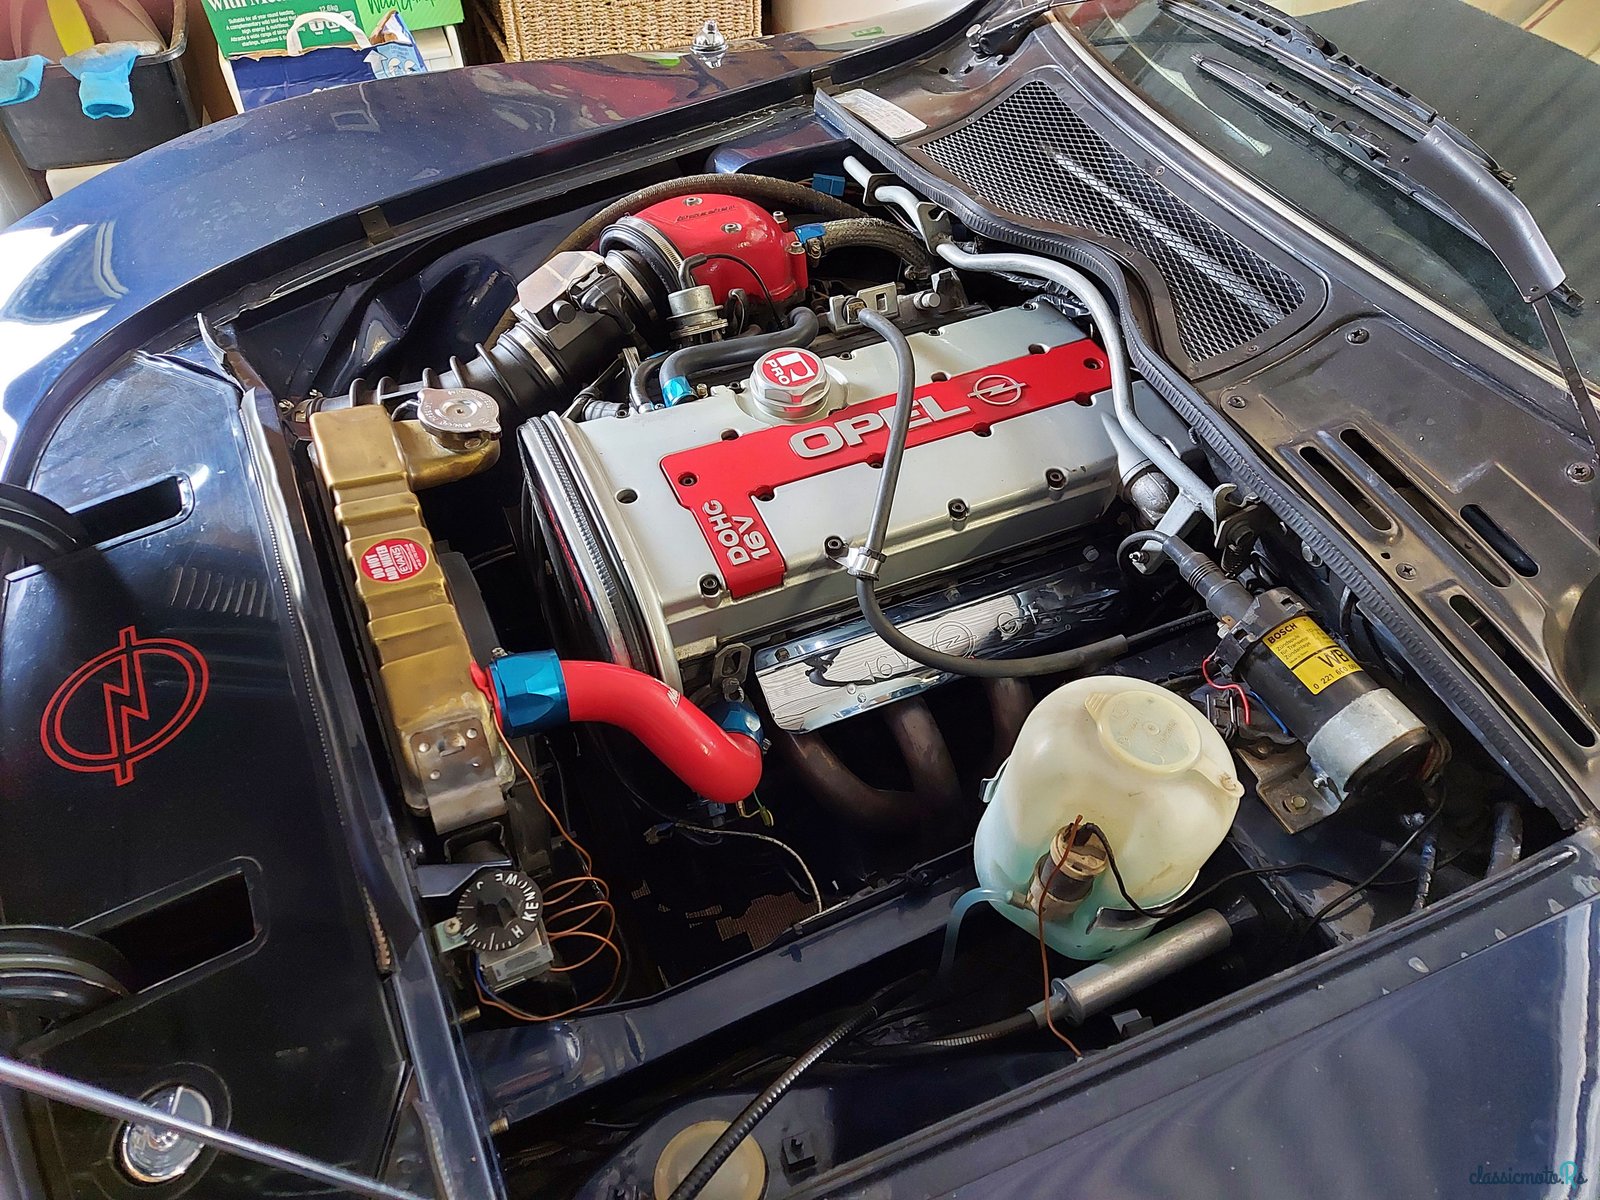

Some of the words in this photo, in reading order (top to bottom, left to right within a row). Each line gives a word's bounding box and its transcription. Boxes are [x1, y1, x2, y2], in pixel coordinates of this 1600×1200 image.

[765, 359, 791, 385] PRO
[789, 396, 971, 458] OPEL
[702, 499, 751, 566] DOHC
[731, 515, 771, 560] 16V
[364, 554, 381, 569] NOT
[375, 544, 394, 568] WATER
[392, 547, 408, 573] EVANS
[371, 567, 386, 579] DO
[384, 566, 400, 581] ADD
[1267, 622, 1298, 645] BOSCH
[1320, 673, 1335, 685] 221
[511, 925, 524, 939] H
